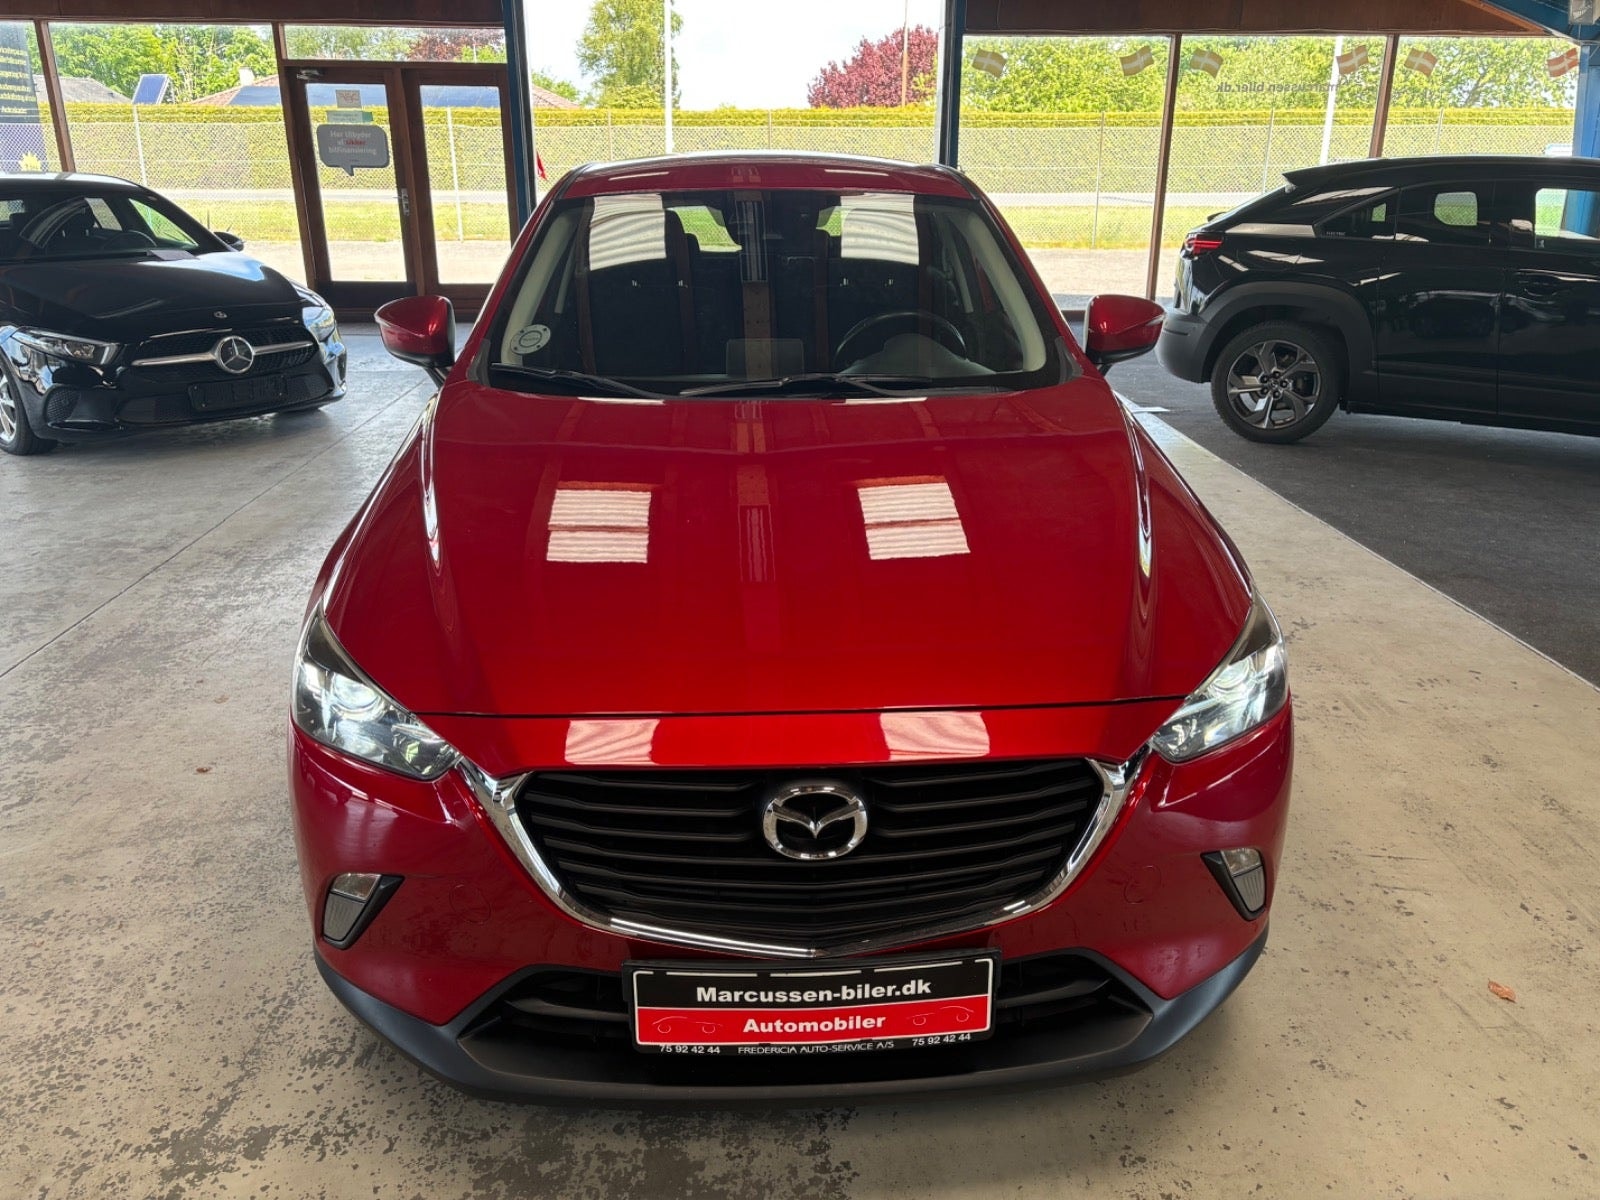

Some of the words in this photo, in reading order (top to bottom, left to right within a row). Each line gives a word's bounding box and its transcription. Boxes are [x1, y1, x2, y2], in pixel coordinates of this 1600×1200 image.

[696, 979, 932, 1003] Marcussen-biler.dk
[742, 1015, 886, 1033] Automobiler
[912, 1038, 925, 1046] 75
[927, 1036, 940, 1045] 92
[943, 1035, 956, 1043] 42
[958, 1033, 971, 1042] 44
[660, 1045, 672, 1053] 75
[675, 1045, 688, 1053] 92
[691, 1046, 704, 1054] 42
[706, 1046, 720, 1054] 44
[738, 1046, 797, 1054] FREDERICIA
[799, 1043, 873, 1053] AUTO-SERVICE
[876, 1041, 894, 1049] A/S
